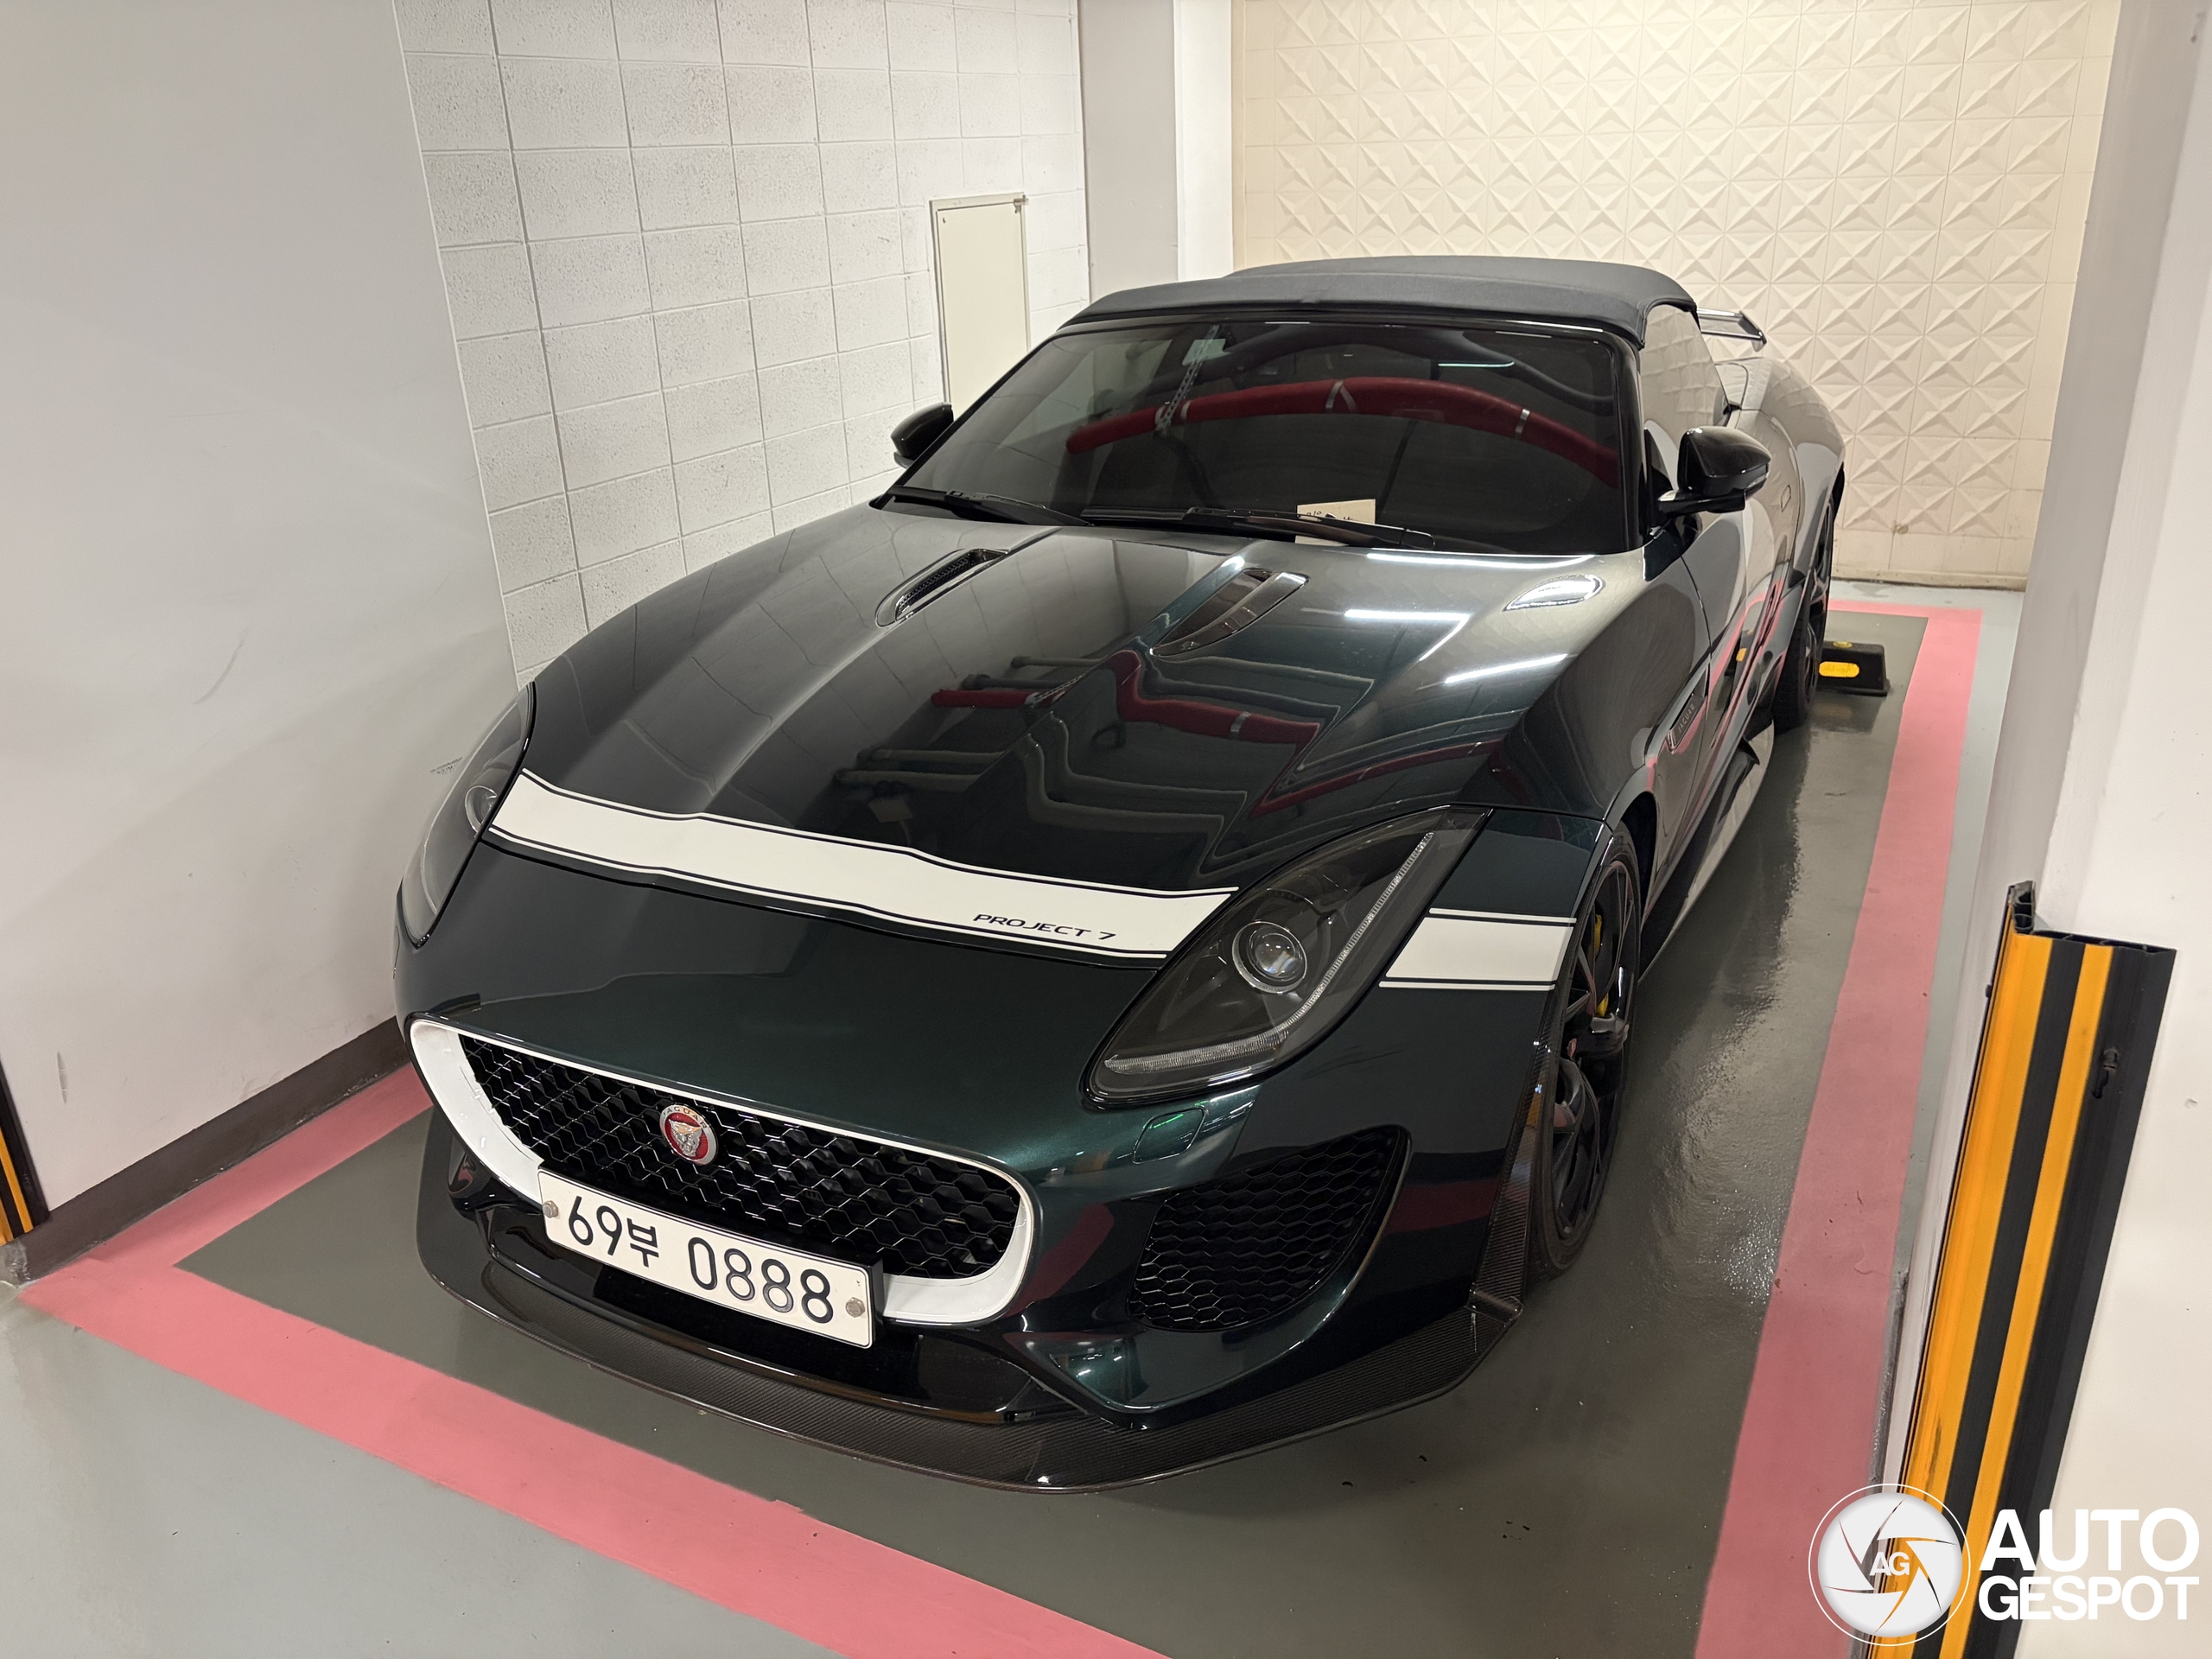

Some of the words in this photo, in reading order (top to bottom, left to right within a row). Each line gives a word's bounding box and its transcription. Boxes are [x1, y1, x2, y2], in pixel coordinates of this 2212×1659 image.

[973, 913, 1091, 937] PROJECT
[1098, 931, 1116, 940] 7
[663, 1106, 708, 1129] JAGUAR
[568, 1195, 660, 1268] 69부
[688, 1236, 835, 1325] 0888
